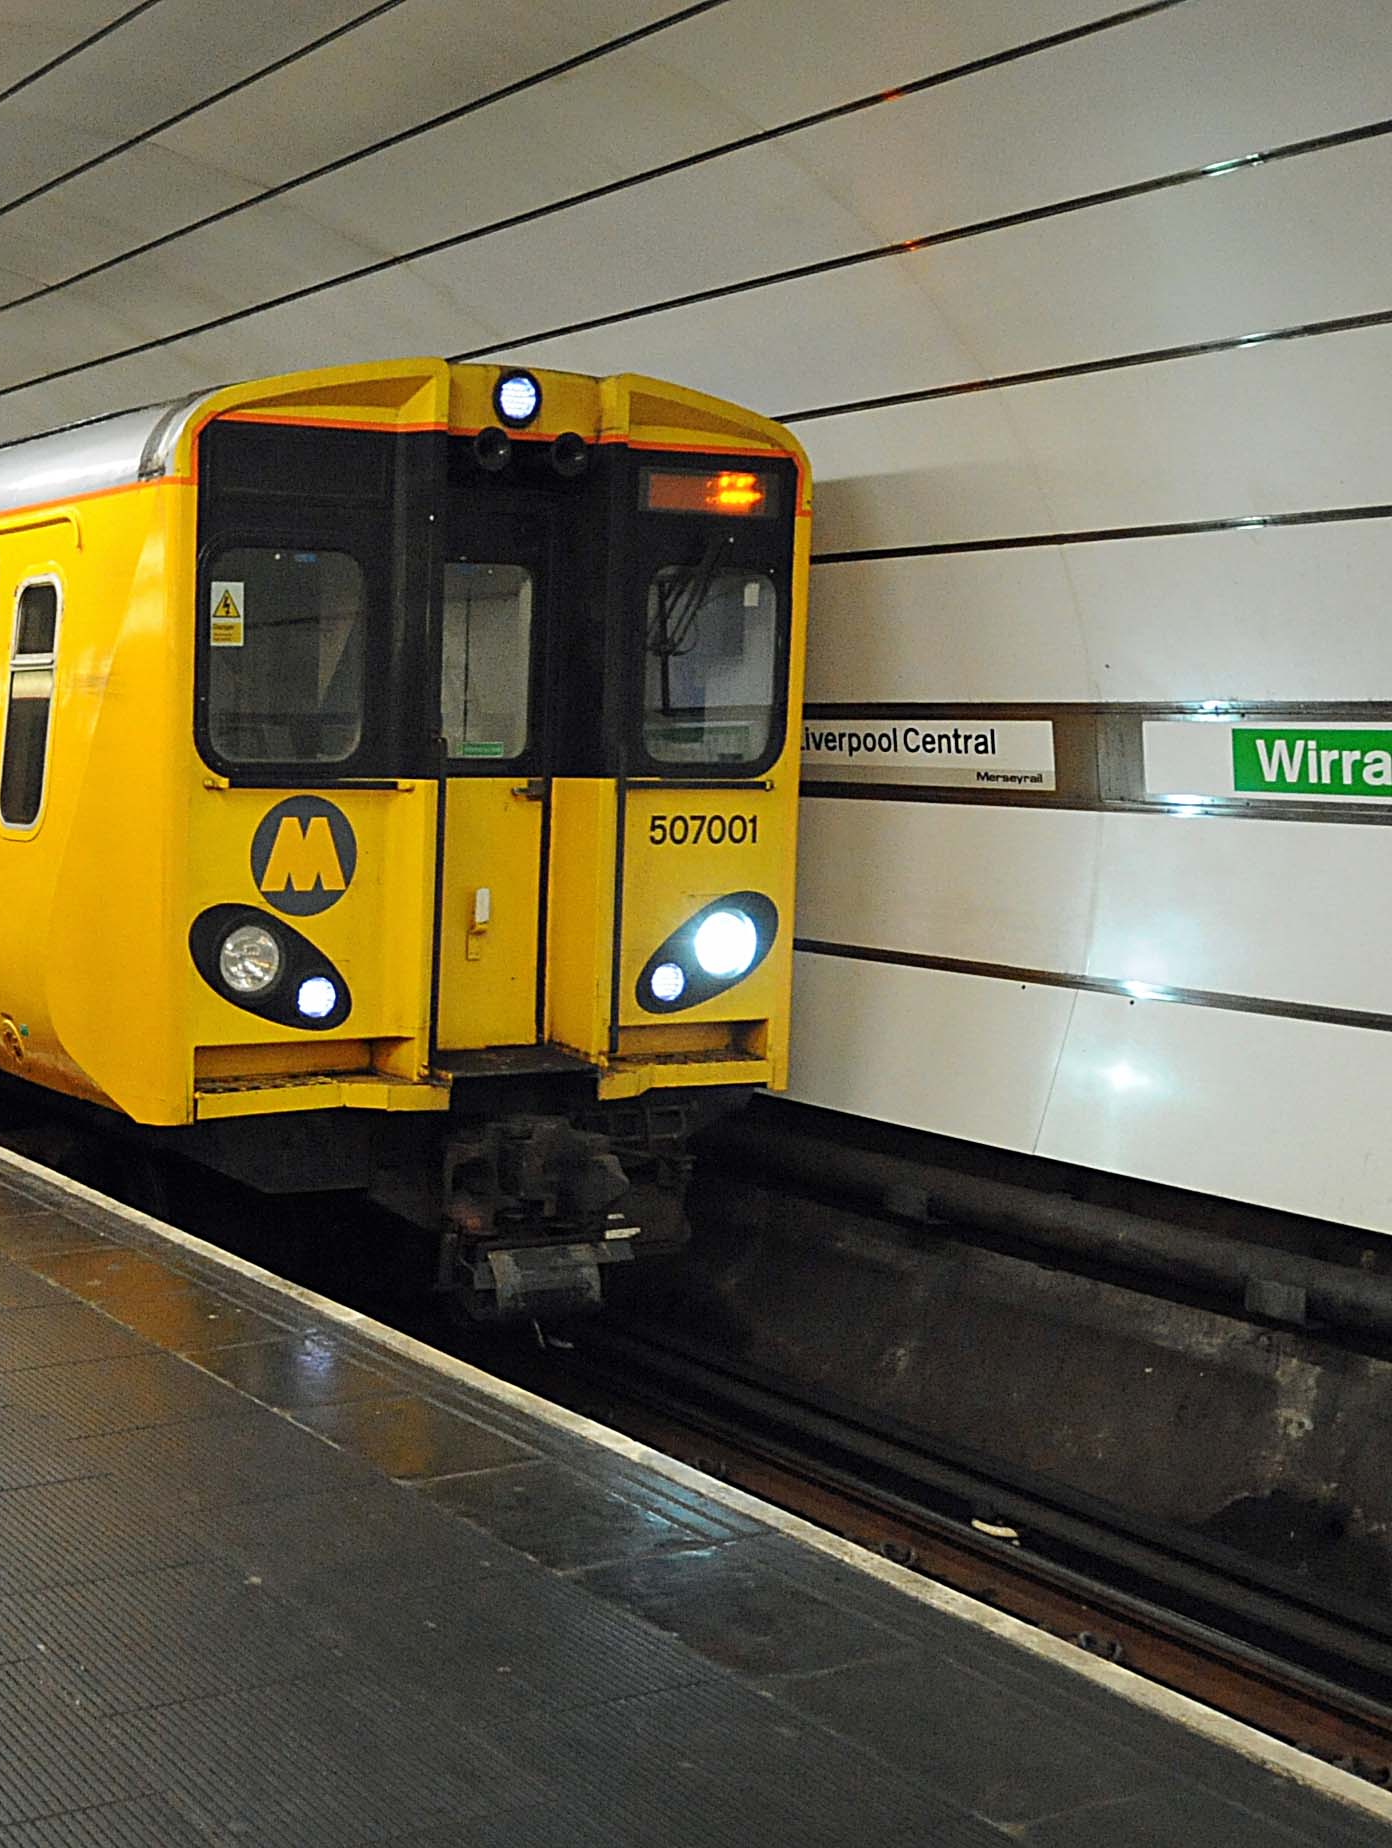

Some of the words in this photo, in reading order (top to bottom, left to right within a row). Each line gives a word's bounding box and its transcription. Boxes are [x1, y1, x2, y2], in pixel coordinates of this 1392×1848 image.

[800, 727, 898, 757] iverpool
[903, 728, 996, 755] Central
[1255, 739, 1392, 786] Wirra
[976, 771, 1045, 785] Merseyrail
[648, 815, 759, 846] 507001
